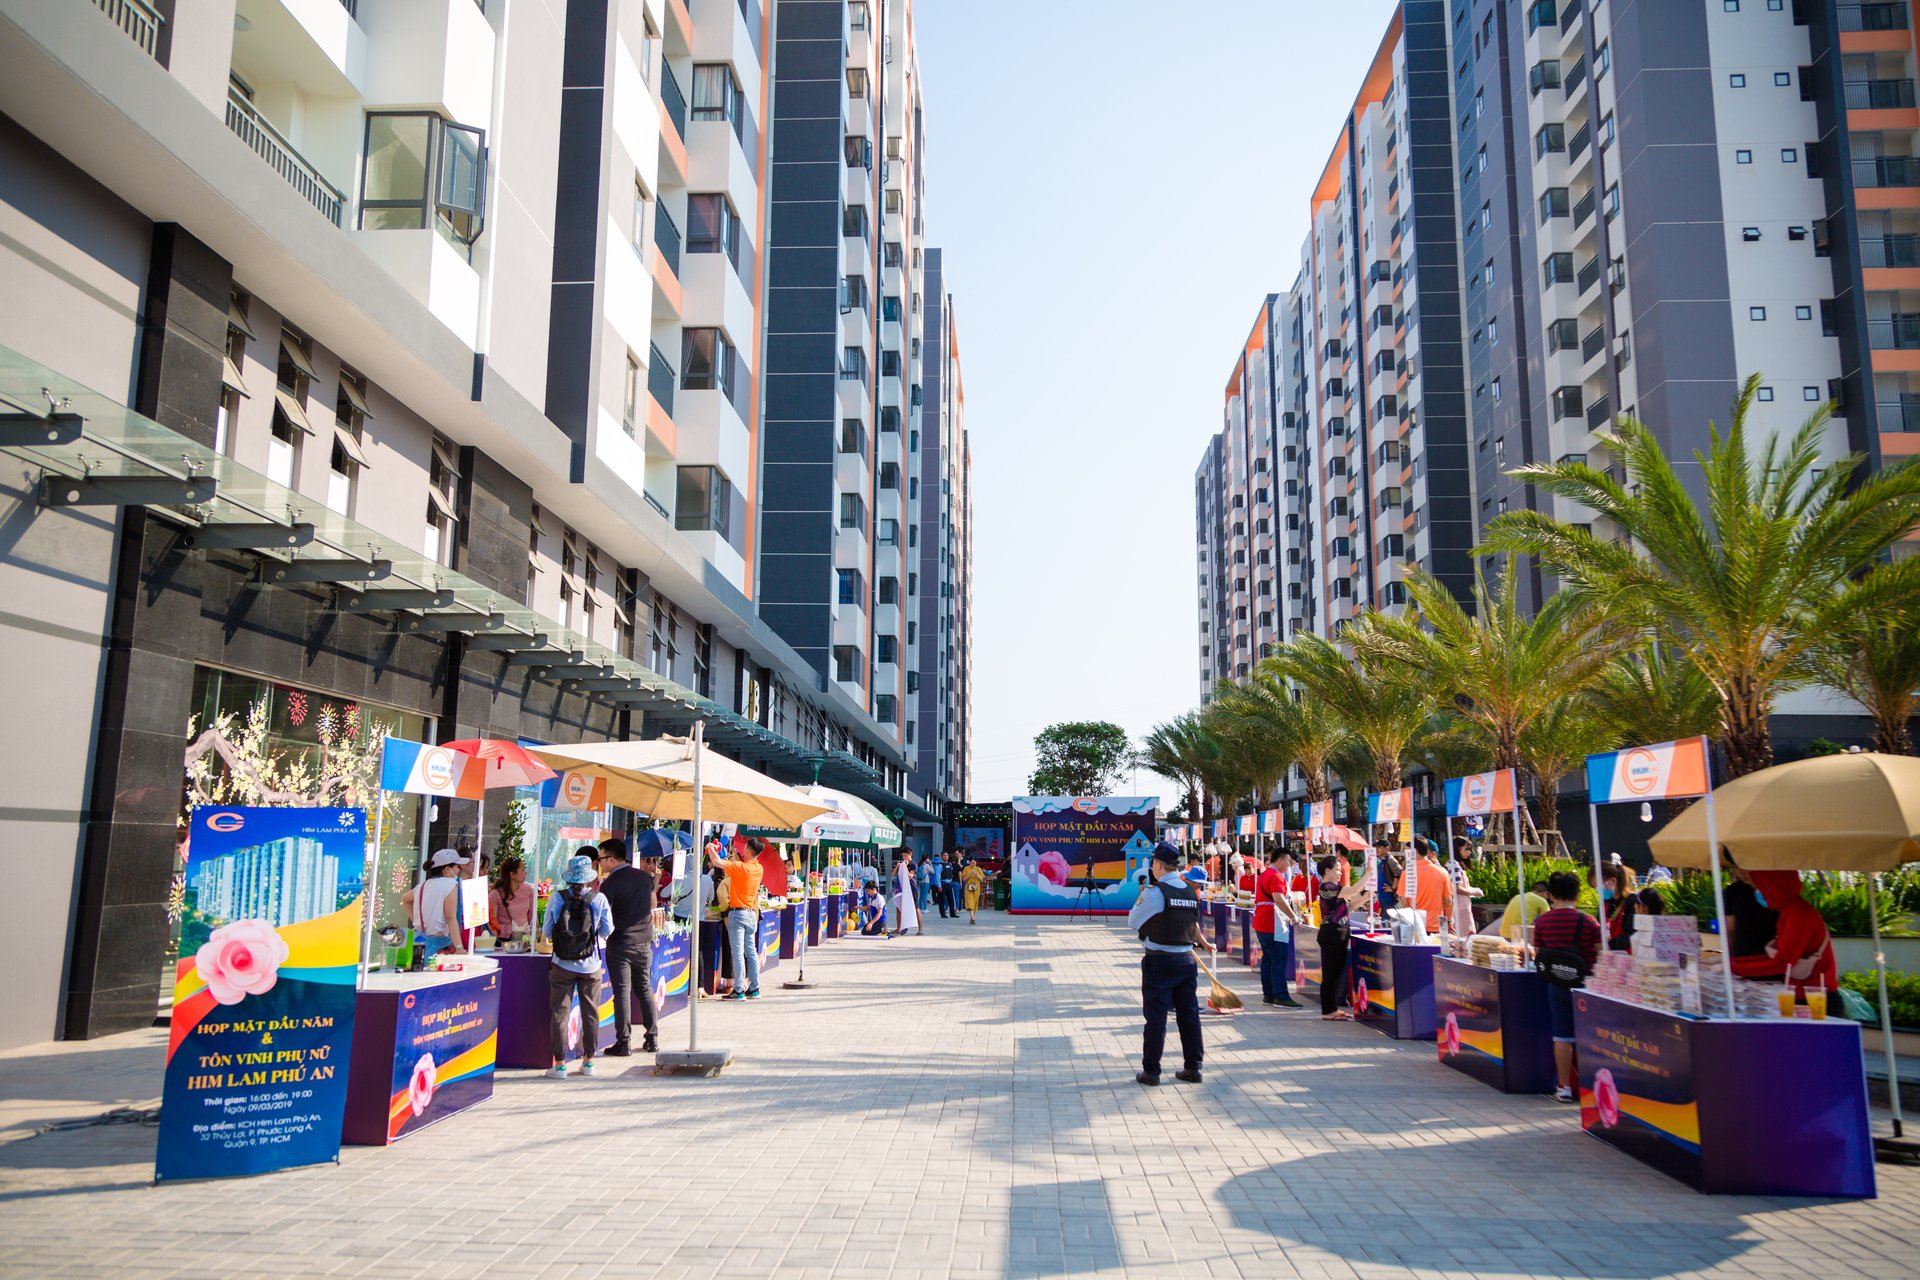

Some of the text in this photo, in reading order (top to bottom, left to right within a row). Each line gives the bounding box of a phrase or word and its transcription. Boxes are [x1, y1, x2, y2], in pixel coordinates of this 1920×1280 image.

[1034, 820, 1134, 832] HỌP MẶT ĐẦU NĂM
[1170, 898, 1198, 909] SECURITY
[197, 1016, 334, 1036] HỌP MẶT ĐẦU NĂM
[261, 1032, 273, 1044] &
[199, 1045, 331, 1068] TÔN VINH PHỤ NỮ
[187, 1064, 335, 1090] HIM LAM PHÚ AN
[224, 1096, 248, 1106] gian:
[250, 1093, 271, 1102] 16:00
[291, 1090, 313, 1099] 19:00
[223, 1101, 293, 1115] Ngày 09/03/2019
[193, 1123, 209, 1134] Địa
[210, 1120, 236, 1132] điểm:
[238, 1120, 256, 1129] KCH
[257, 1118, 273, 1127] Him
[274, 1116, 292, 1125] Lam
[293, 1114, 308, 1124] Phú
[284, 1124, 304, 1134] Long
[270, 1134, 291, 1144] HCM
